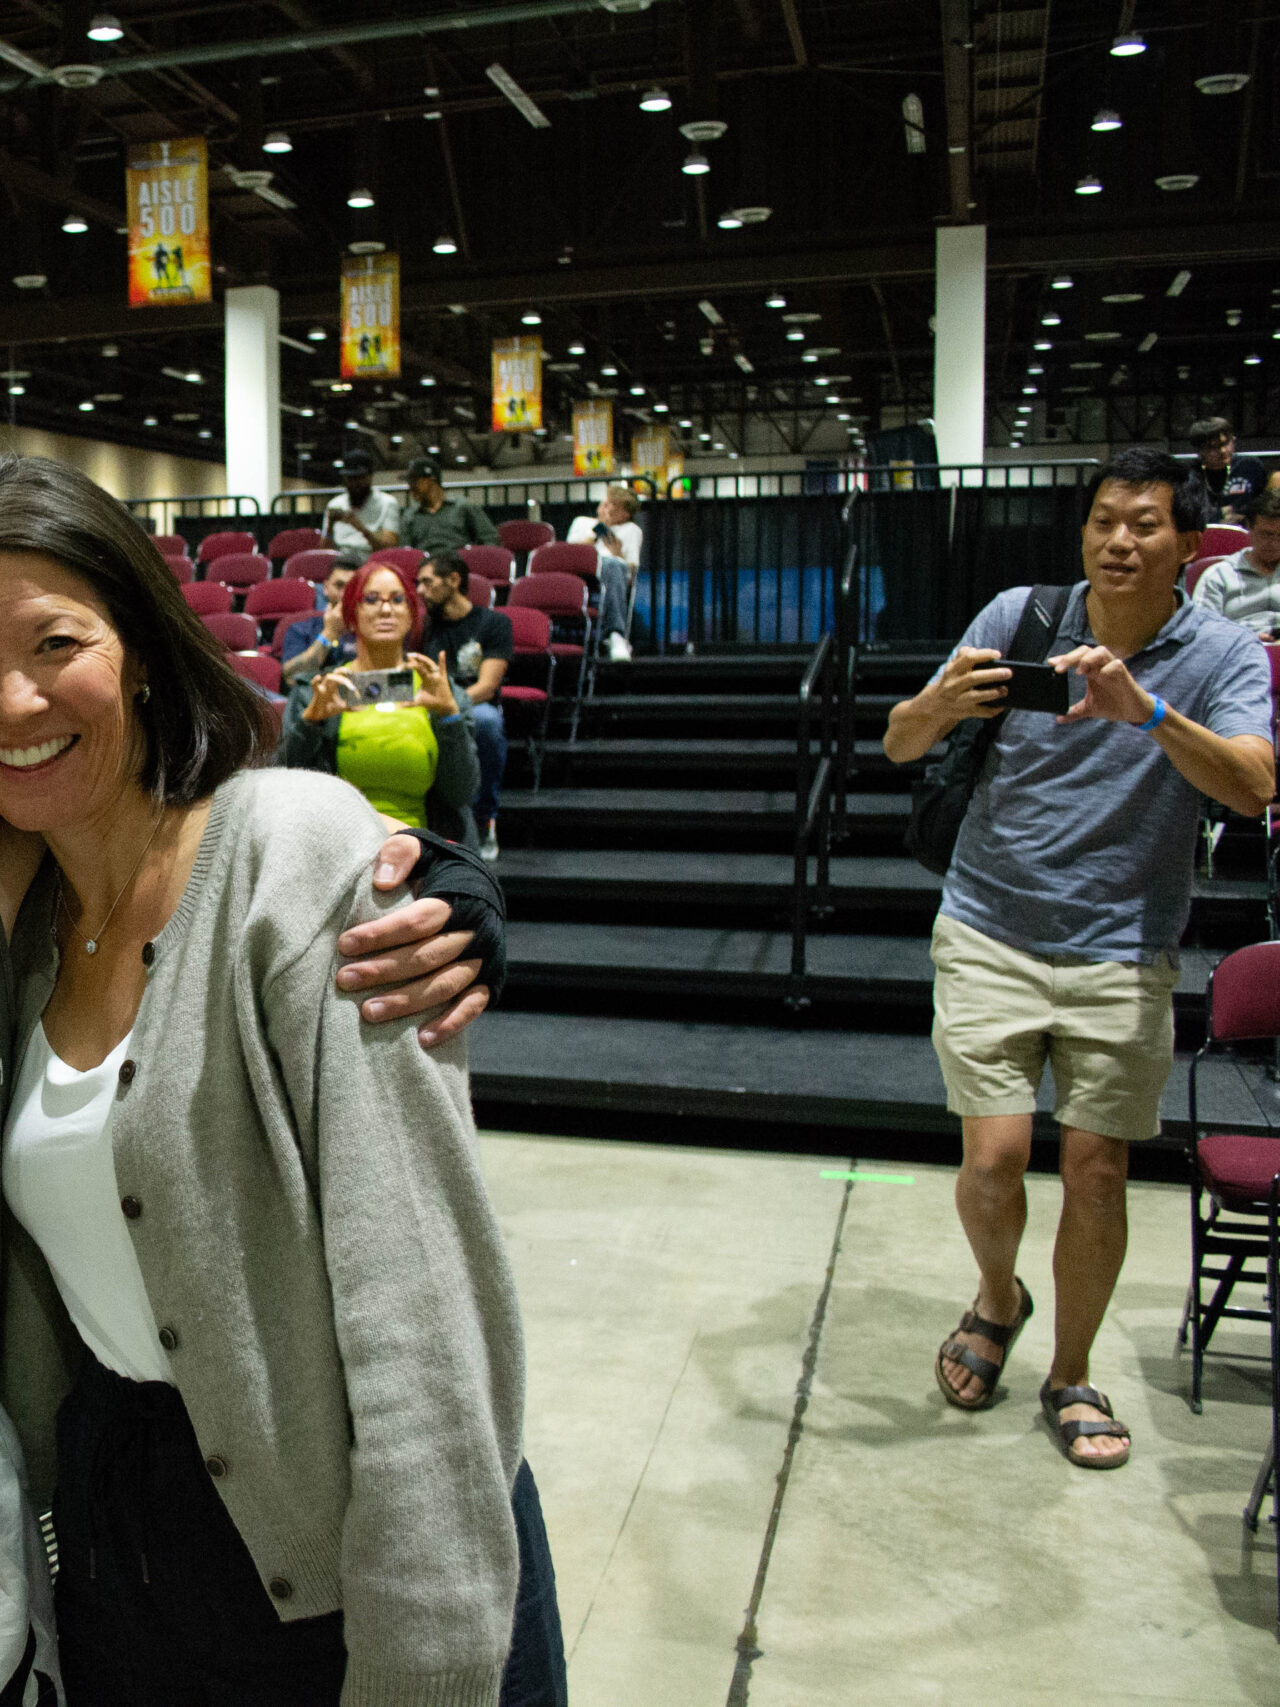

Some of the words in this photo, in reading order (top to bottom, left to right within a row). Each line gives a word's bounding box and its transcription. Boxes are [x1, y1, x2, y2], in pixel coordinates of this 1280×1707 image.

[139, 178, 196, 206] AISLE
[140, 203, 196, 238] 500
[350, 302, 391, 328] 600
